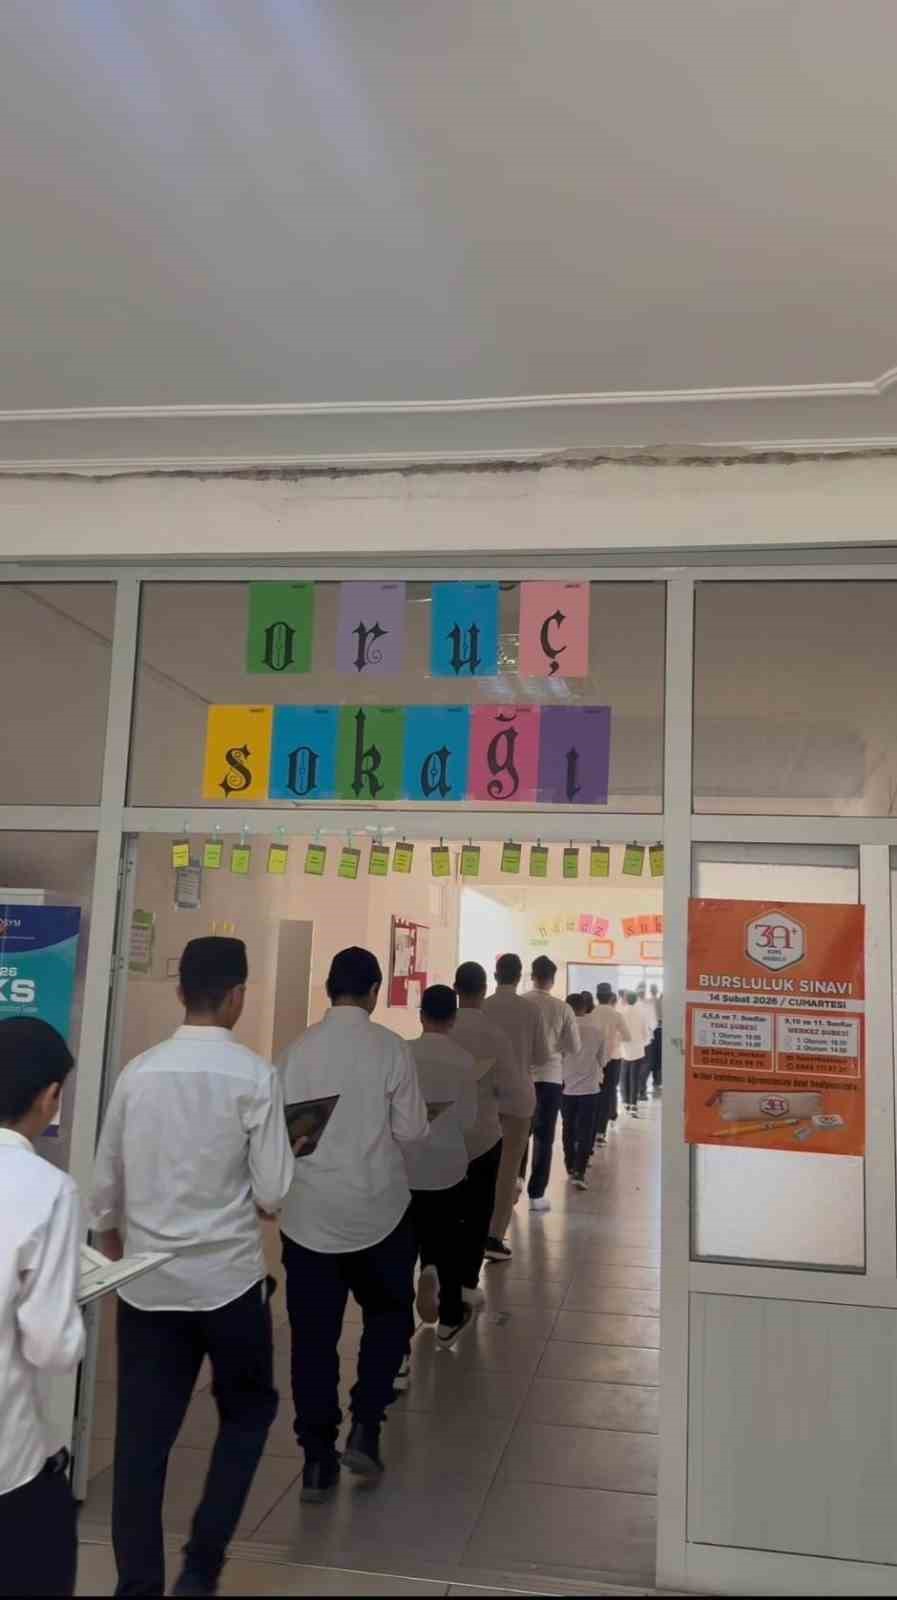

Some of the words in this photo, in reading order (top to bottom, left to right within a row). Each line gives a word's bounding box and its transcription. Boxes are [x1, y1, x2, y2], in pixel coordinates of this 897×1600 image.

[261, 609, 568, 676] oruç
[218, 707, 582, 800] sokağı
[699, 974, 794, 992] BURSLULUK
[800, 979, 853, 995] SINAVI
[709, 992, 720, 1001] 14
